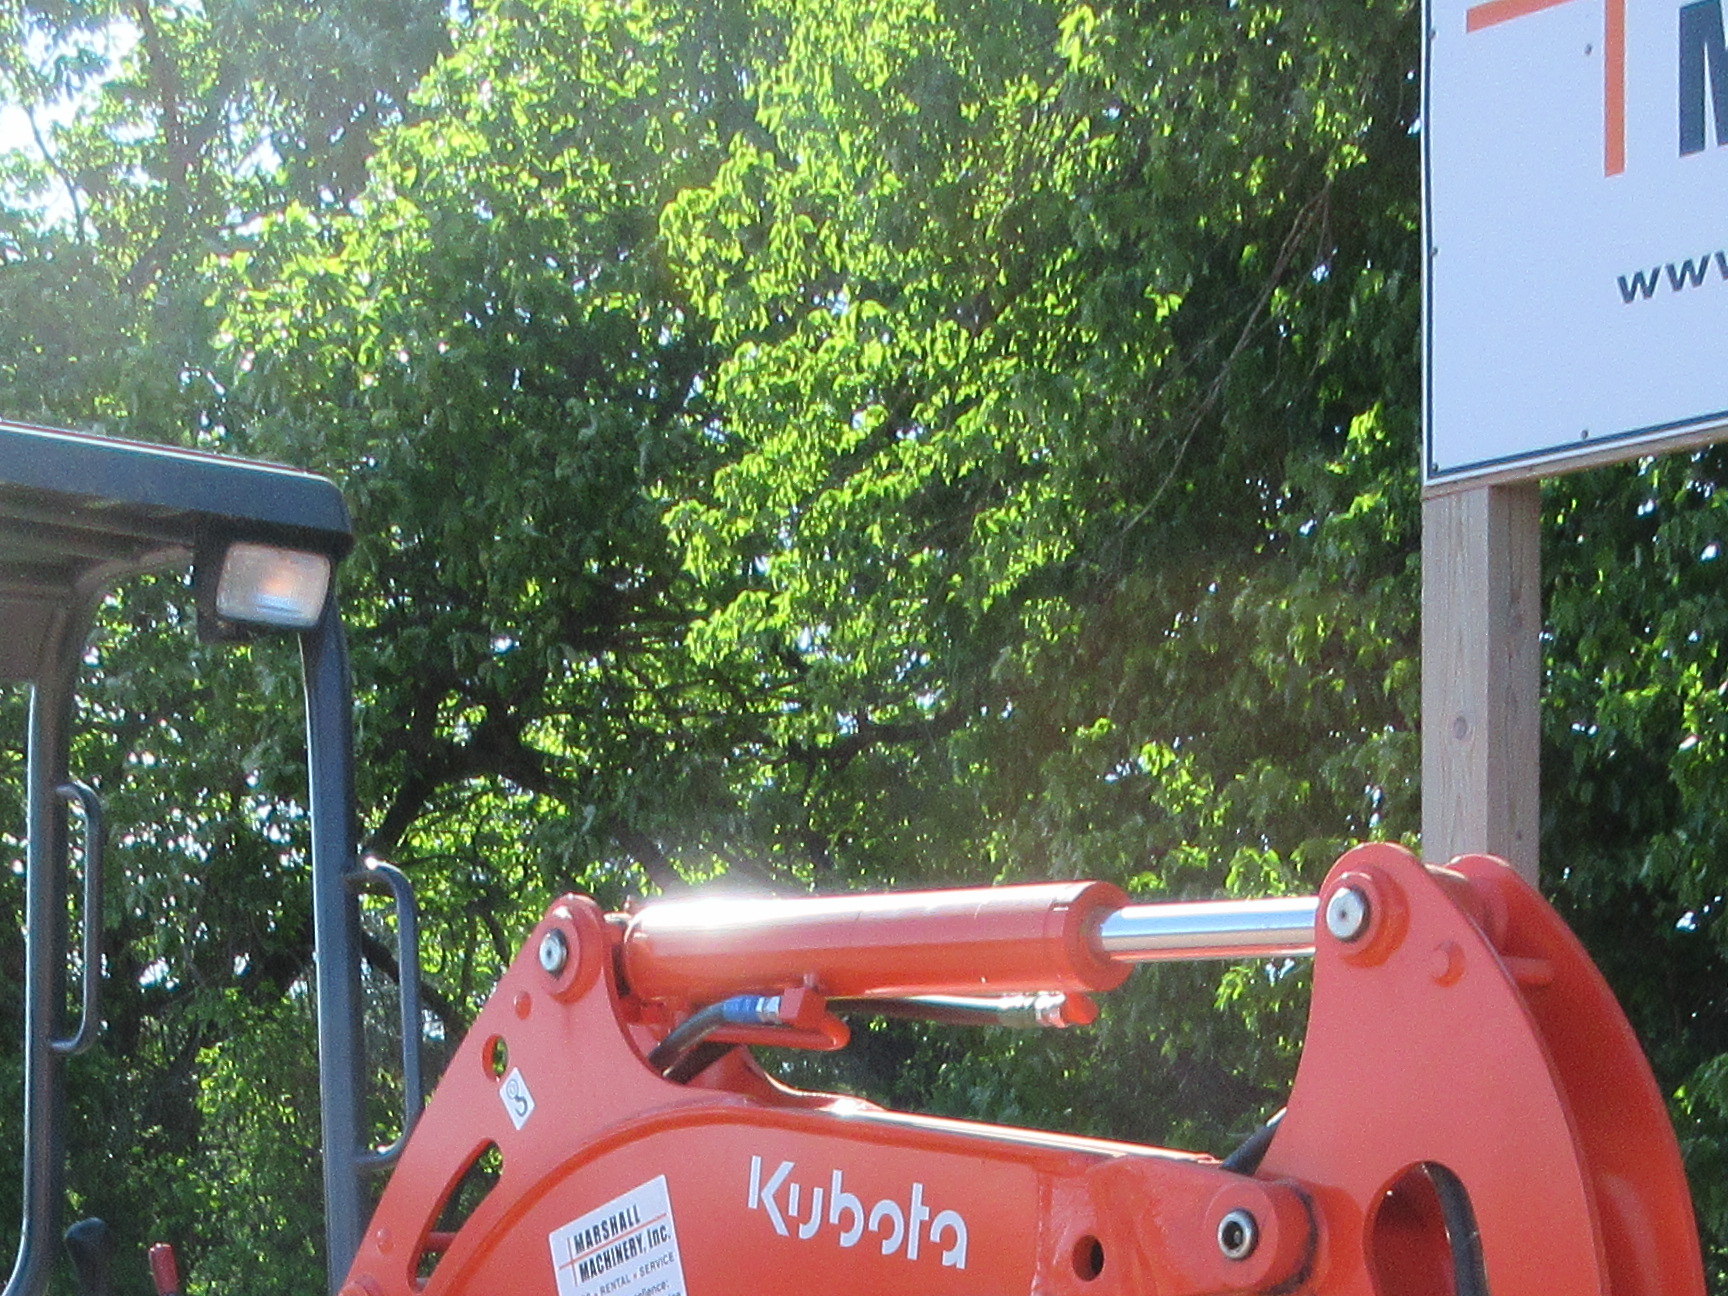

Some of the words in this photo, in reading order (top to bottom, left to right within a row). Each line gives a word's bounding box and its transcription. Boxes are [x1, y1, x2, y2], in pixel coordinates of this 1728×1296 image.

[574, 1204, 641, 1254] MARSHALL
[747, 1154, 969, 1270] Kubota
[578, 1232, 647, 1283] MACHINERY,
[647, 1224, 672, 1250] Inc.
[599, 1274, 632, 1296] RENTAL
[639, 1251, 675, 1278] SERVICE
